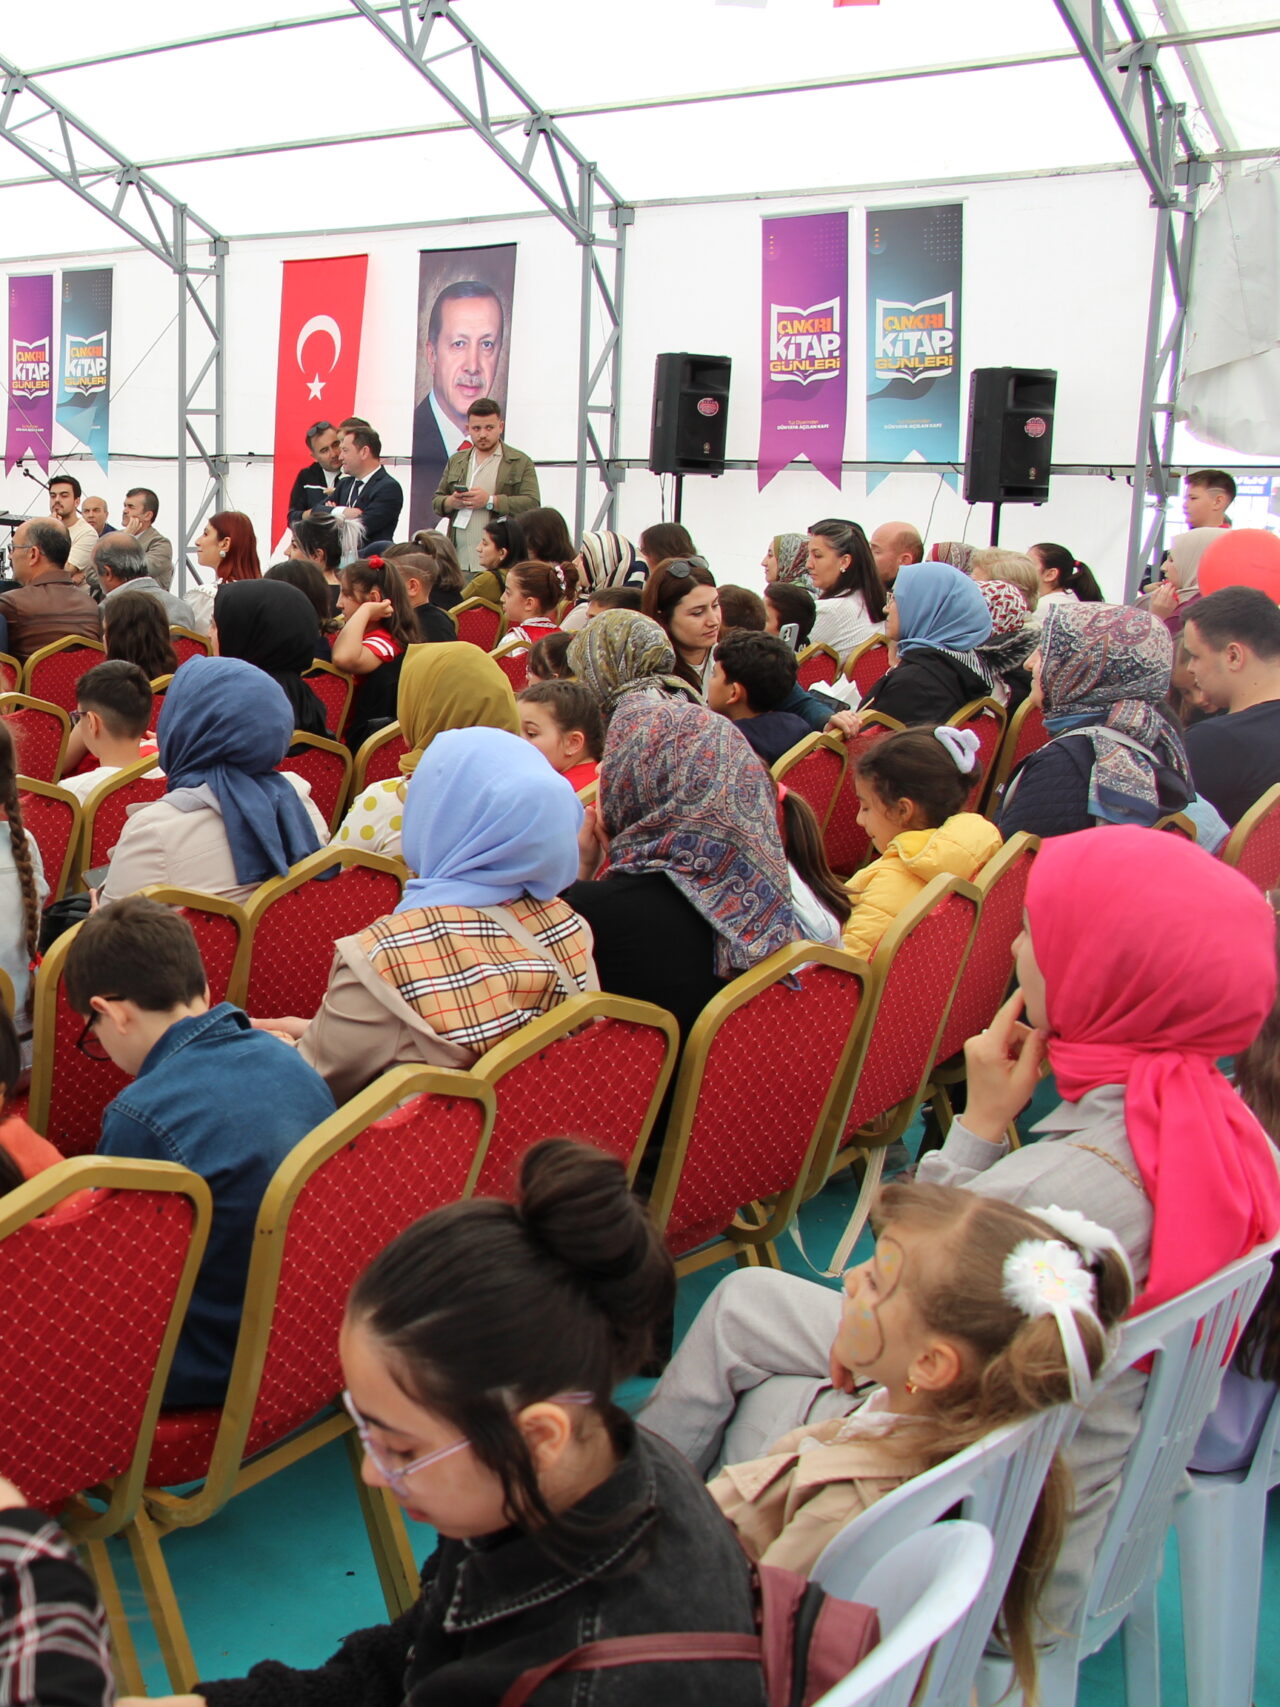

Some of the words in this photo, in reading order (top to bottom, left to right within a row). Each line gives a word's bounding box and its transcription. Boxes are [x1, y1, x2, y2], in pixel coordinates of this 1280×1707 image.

[770, 333, 841, 361] KİTAP
[876, 329, 953, 358] KİTAP
[13, 362, 50, 381] KİTAP
[65, 357, 108, 378] KİTAP
[770, 357, 841, 372] GÜNLERİ
